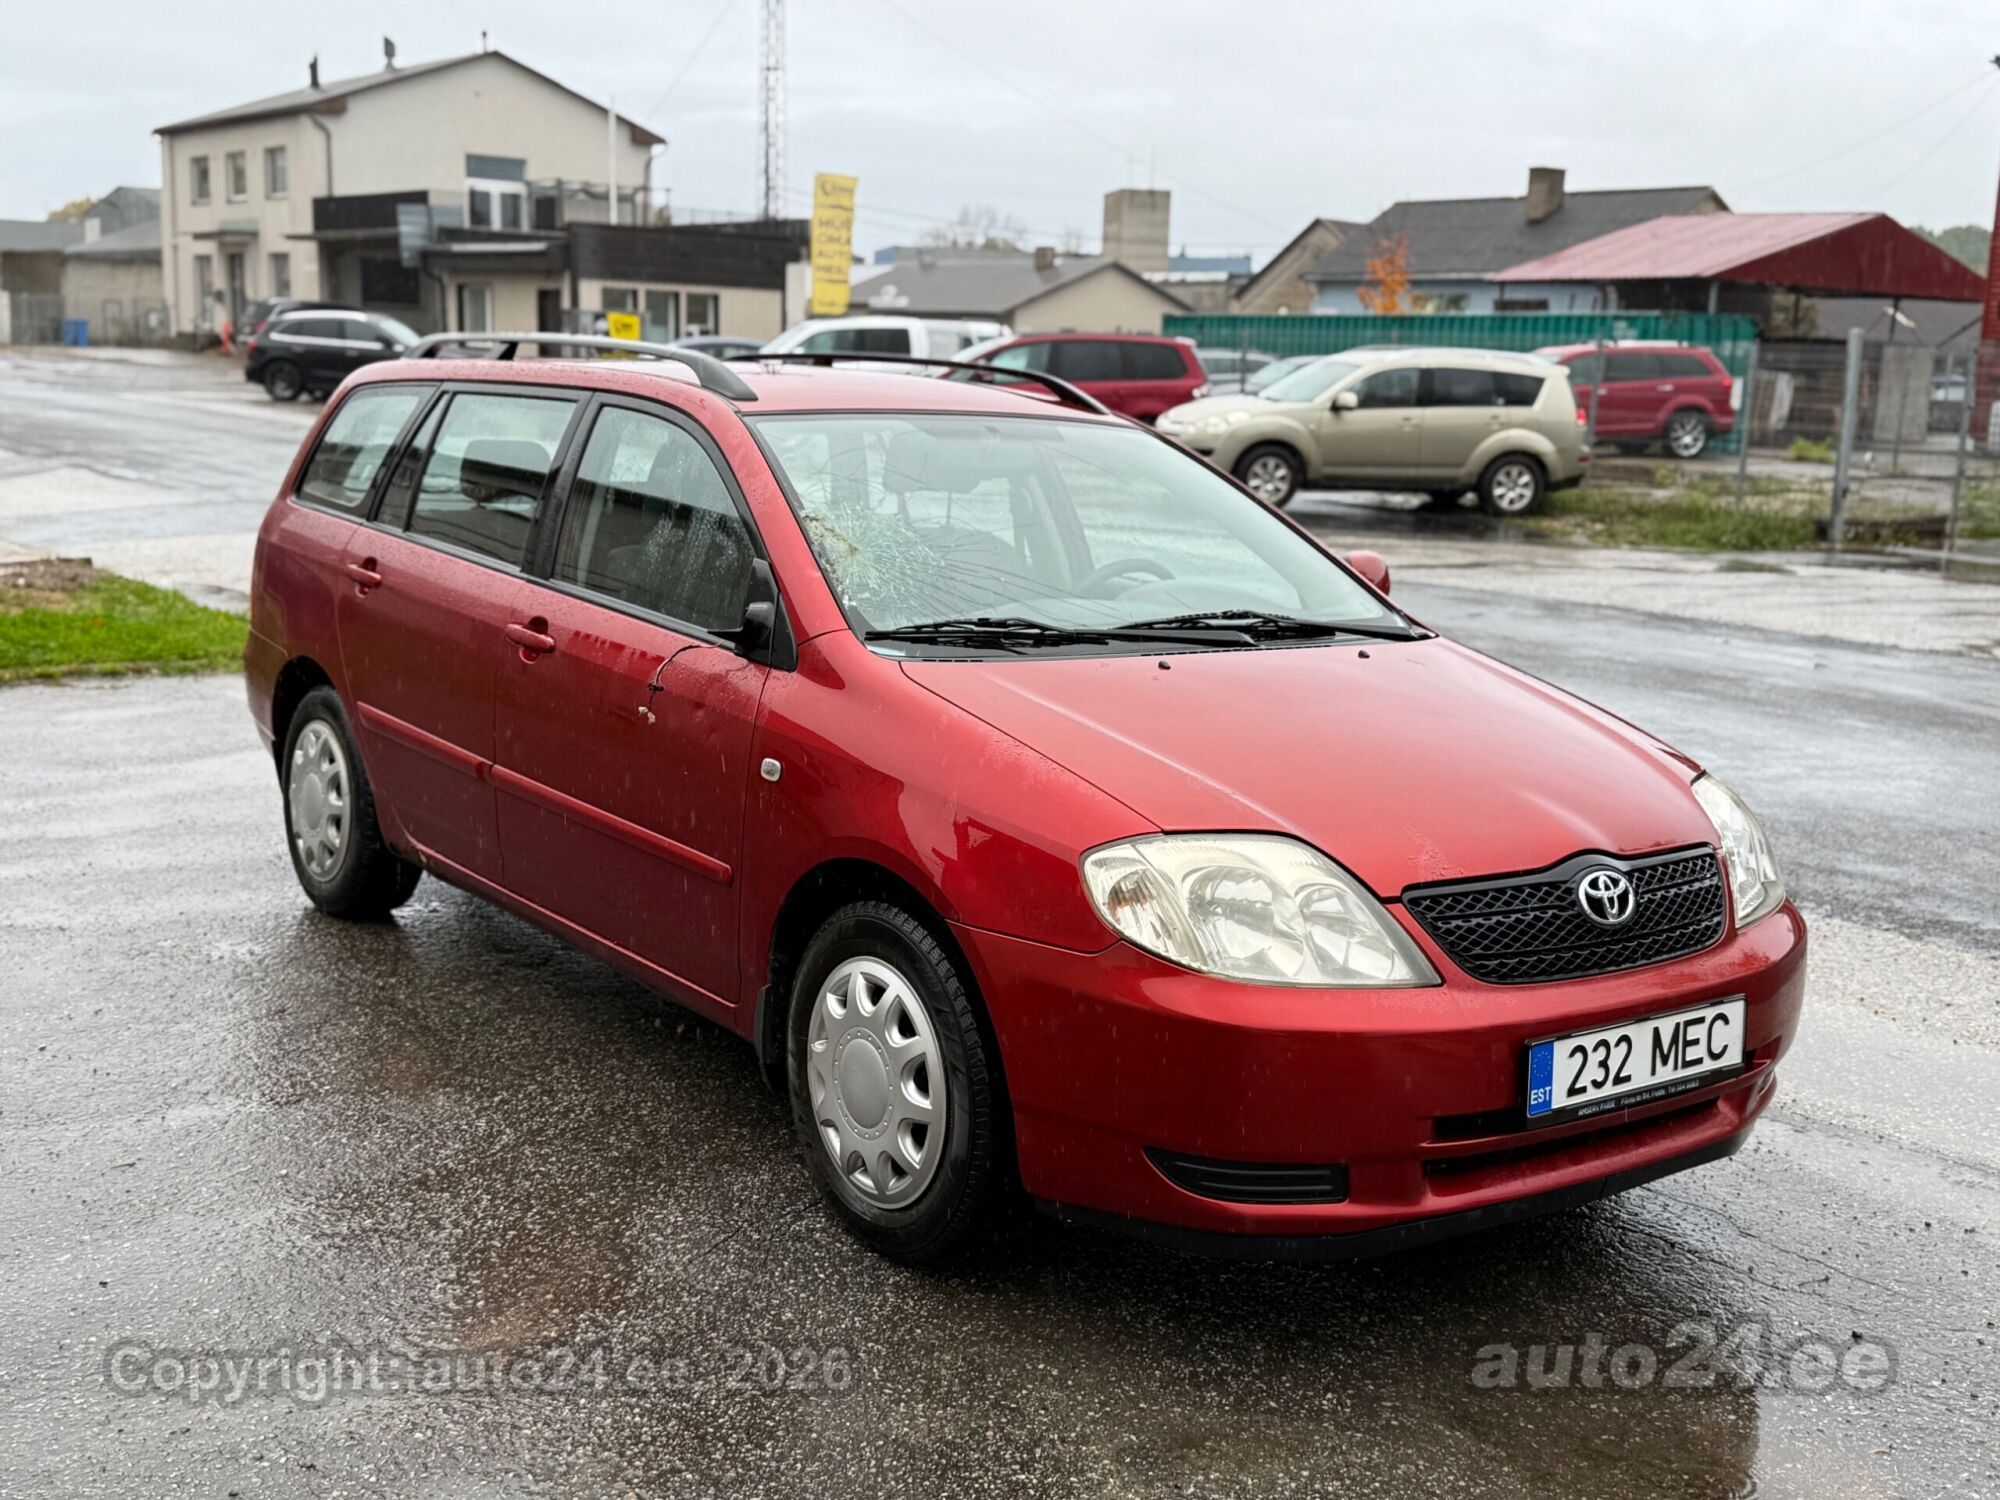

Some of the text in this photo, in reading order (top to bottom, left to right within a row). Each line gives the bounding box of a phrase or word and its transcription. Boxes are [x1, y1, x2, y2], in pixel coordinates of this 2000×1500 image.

[1566, 1012, 1730, 1098] 232 MEC
[1531, 1086, 1551, 1105] EST
